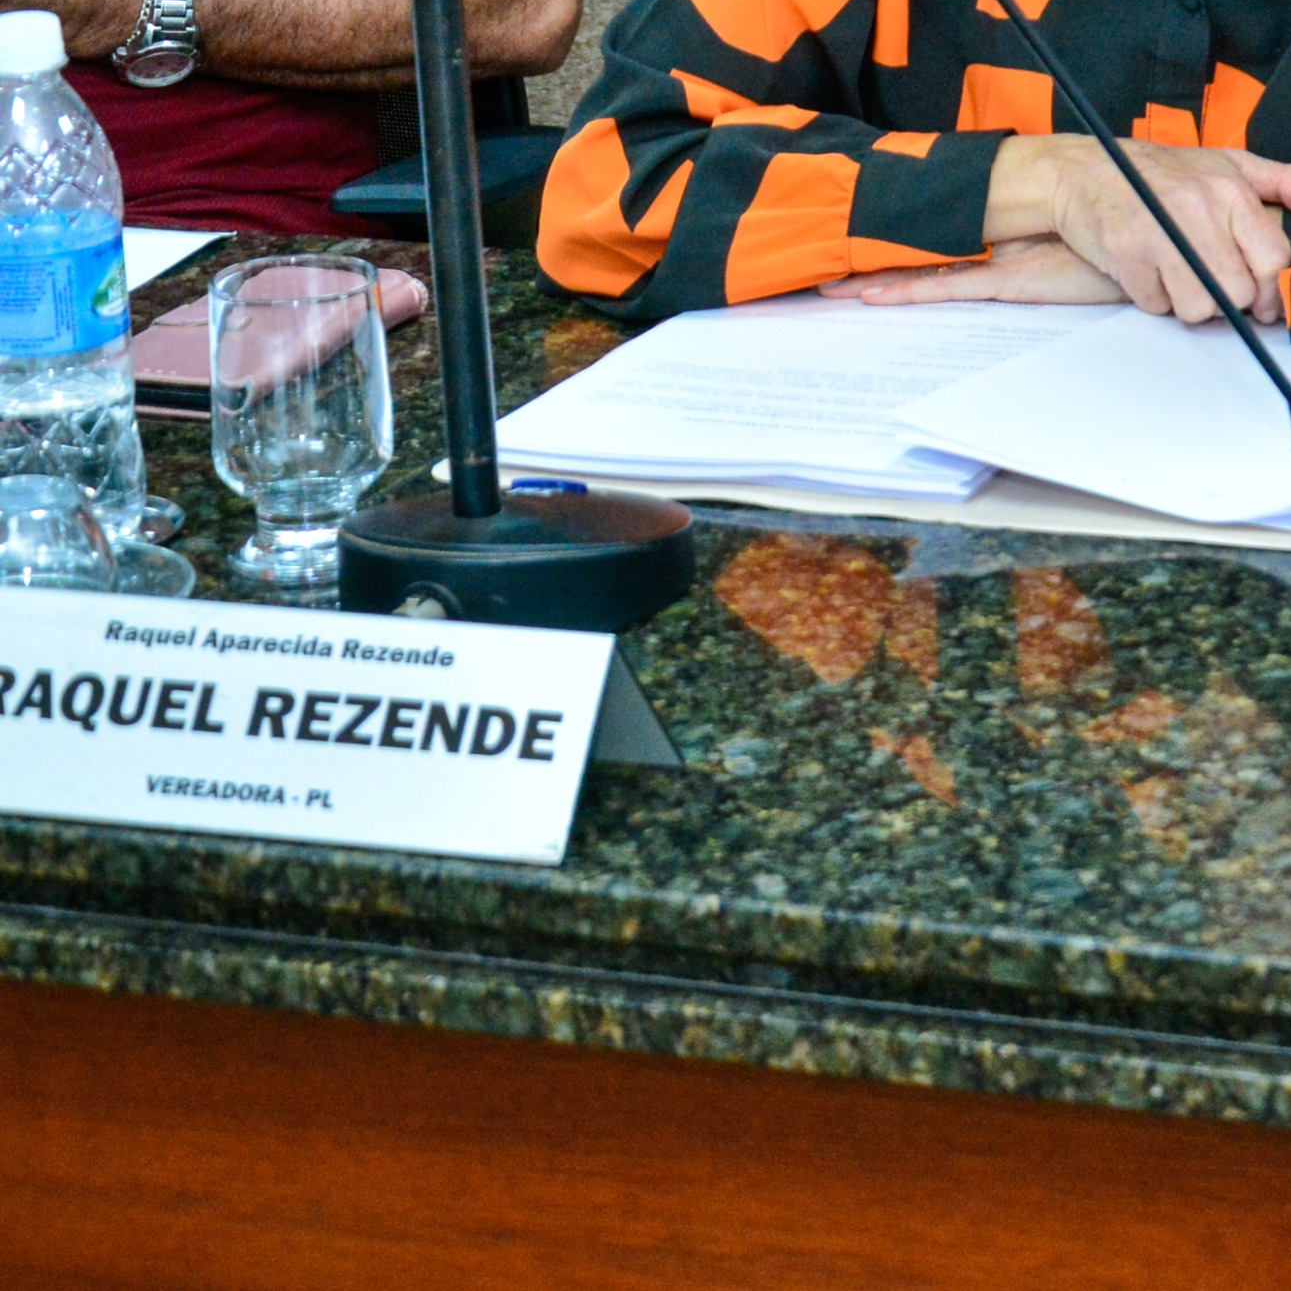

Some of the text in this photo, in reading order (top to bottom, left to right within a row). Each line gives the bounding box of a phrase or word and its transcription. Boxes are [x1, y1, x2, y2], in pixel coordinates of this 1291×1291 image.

[105, 621, 455, 667] Raquel Aparecida Rezende
[247, 687, 563, 762] REZENDE
[147, 775, 286, 804] VEREADORA
[305, 789, 333, 809] PL
